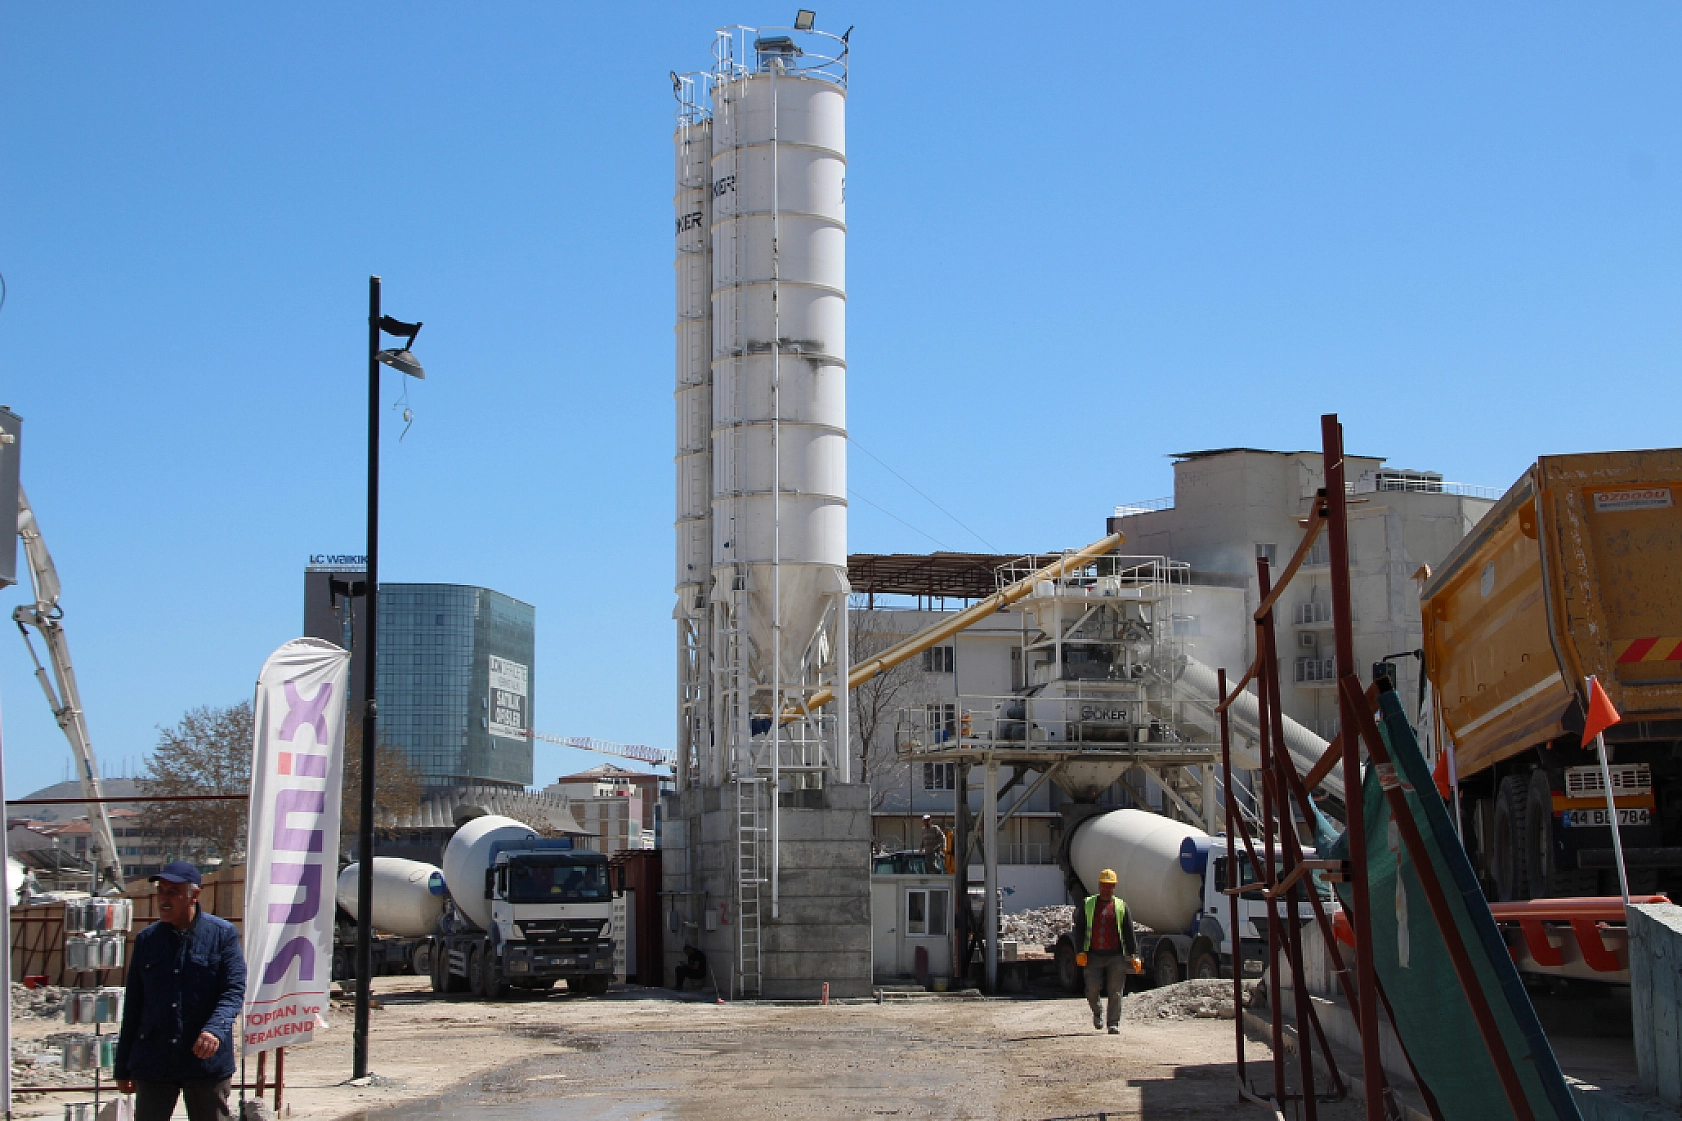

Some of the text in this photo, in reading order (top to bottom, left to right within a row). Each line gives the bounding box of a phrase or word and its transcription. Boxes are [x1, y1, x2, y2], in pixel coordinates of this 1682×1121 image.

[309, 554, 325, 564] LC
[1570, 811, 1588, 824] 44
[1620, 810, 1647, 824] 784
[302, 1006, 321, 1014] ve
